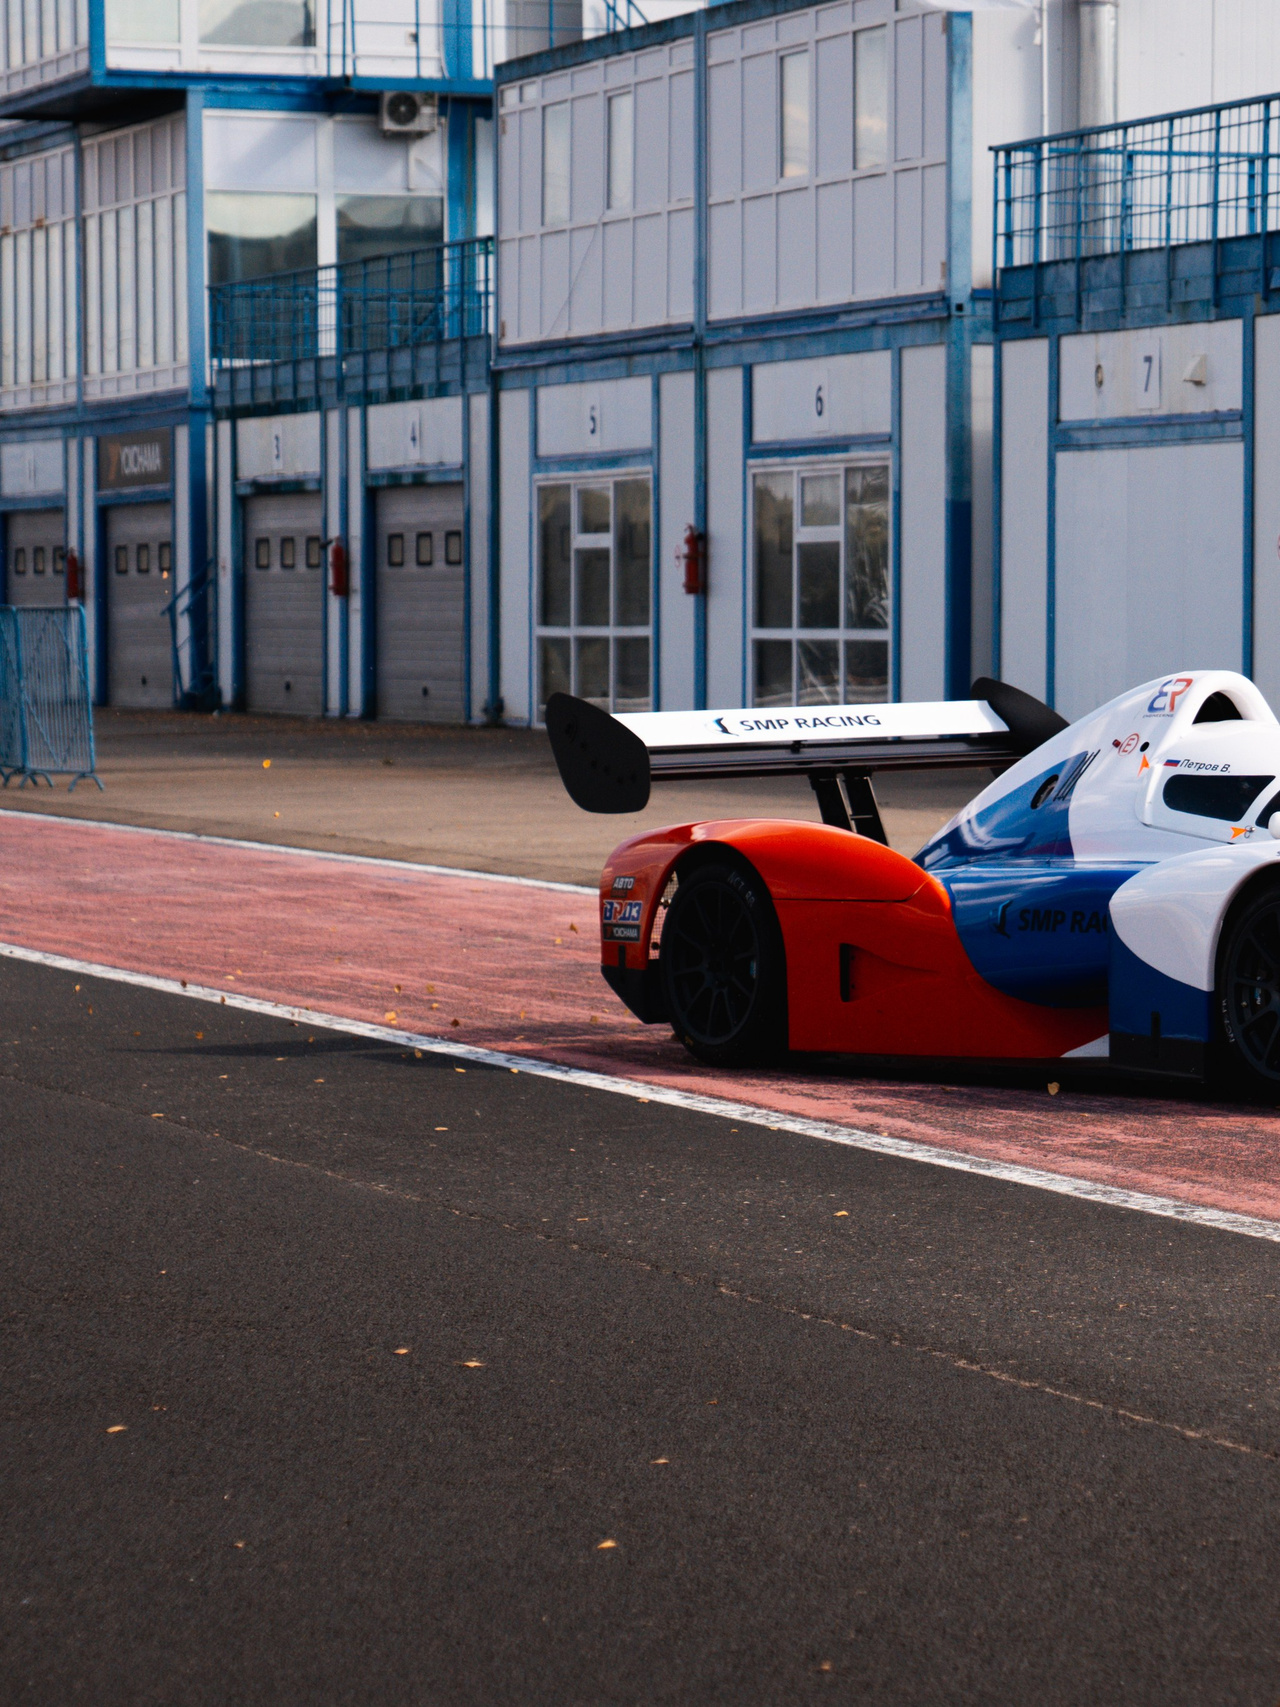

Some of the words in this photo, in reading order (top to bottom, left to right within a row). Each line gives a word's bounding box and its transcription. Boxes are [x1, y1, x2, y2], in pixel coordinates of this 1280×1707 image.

[1143, 355, 1153, 393] 7
[815, 384, 824, 417] 6
[589, 405, 597, 435] 5
[740, 718, 789, 731] SMP
[794, 714, 882, 729] RACING
[1180, 759, 1219, 772] Петров
[1018, 909, 1066, 931] SMP
